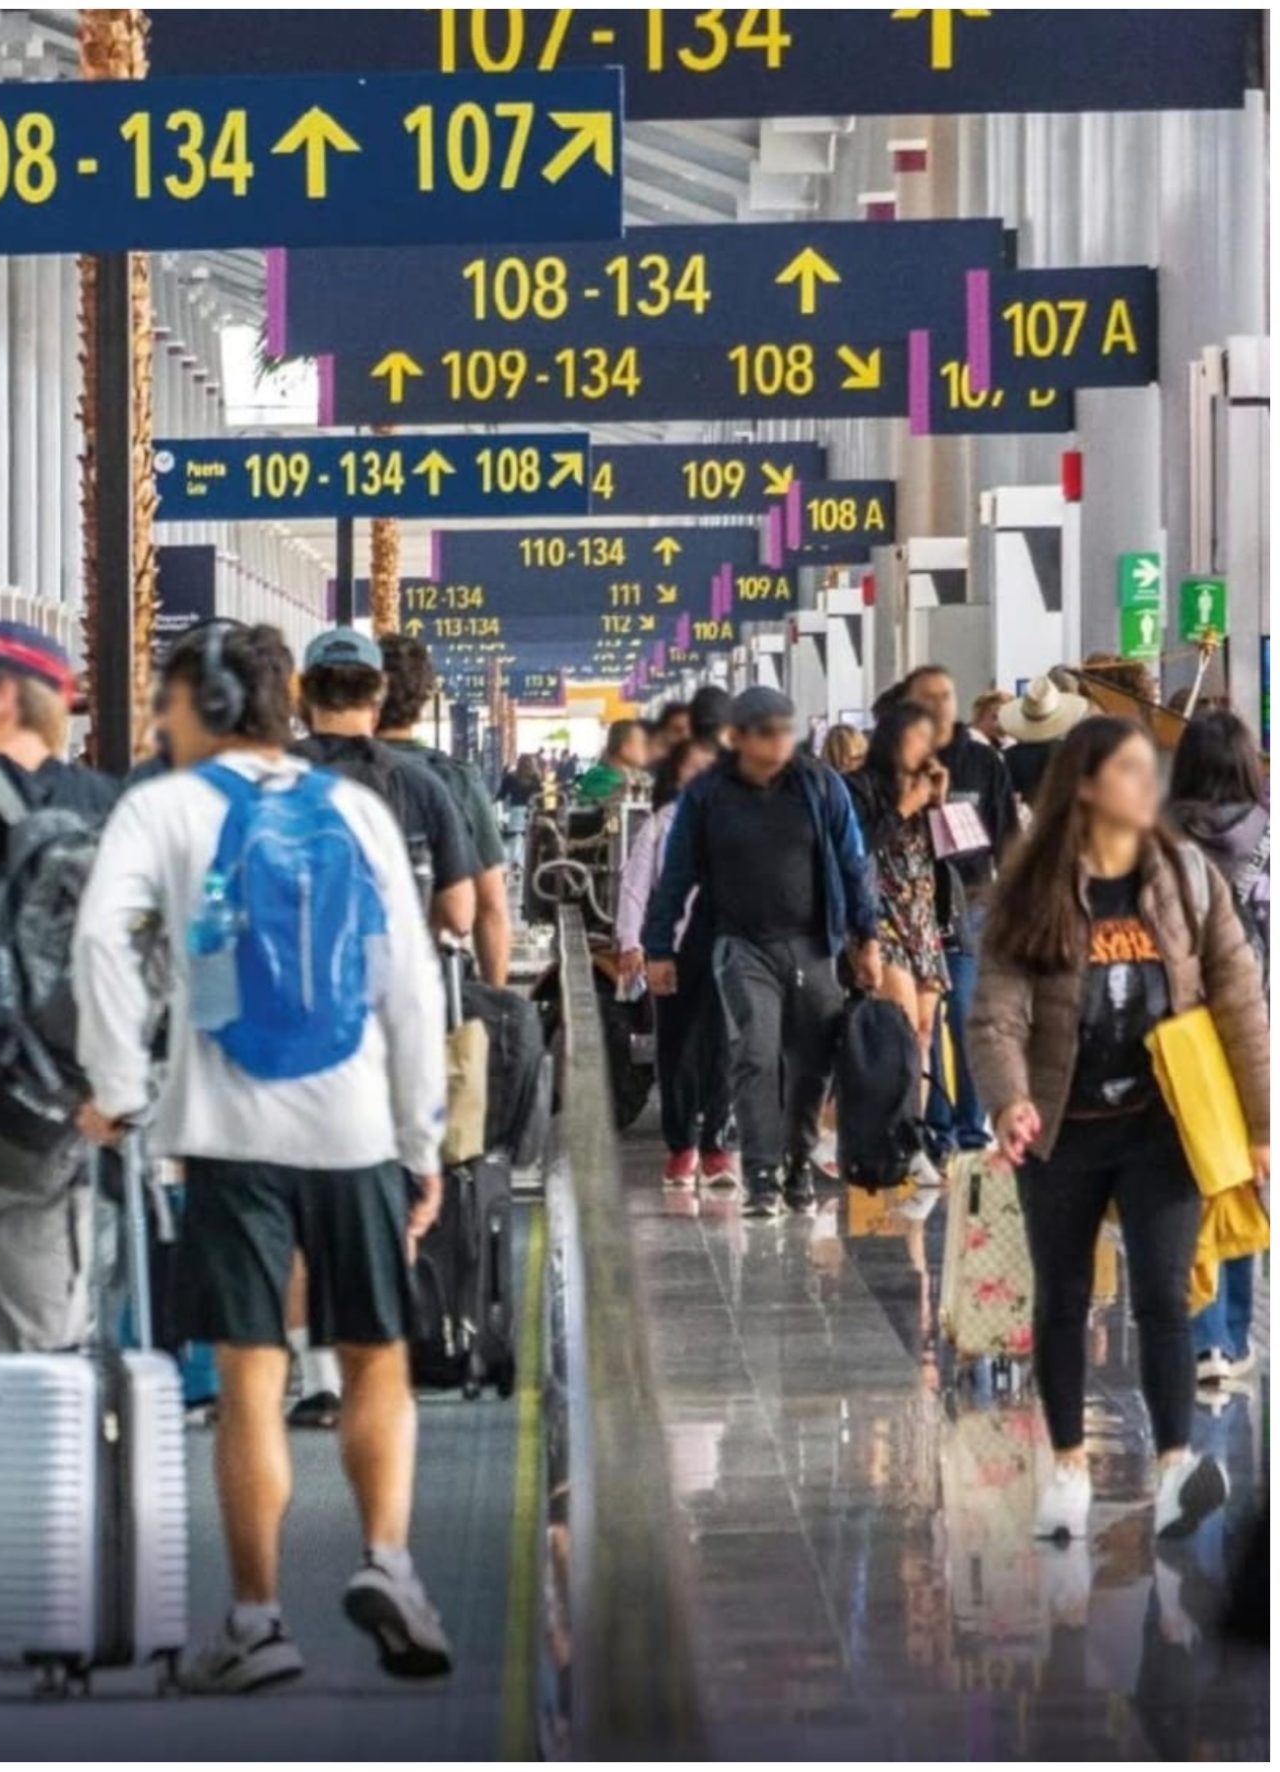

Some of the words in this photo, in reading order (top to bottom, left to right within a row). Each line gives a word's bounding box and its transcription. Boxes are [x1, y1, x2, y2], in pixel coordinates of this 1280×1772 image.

[119, 109, 254, 200] 134
[403, 101, 535, 192] 107
[462, 255, 569, 320] 108
[1002, 299, 1088, 358] 107
[1101, 298, 1138, 355] A
[728, 342, 815, 396] 108
[245, 451, 311, 498] 109
[340, 450, 406, 496] 134
[475, 446, 542, 493] 108
[682, 459, 746, 499] 109
[807, 498, 858, 532] 108
[864, 498, 885, 531] A
[519, 536, 626, 567] 110-134
[609, 582, 642, 606] 111
[736, 575, 772, 600] 109
[775, 575, 791, 599] A
[600, 614, 632, 634] 112
[693, 620, 720, 641] 110
[721, 621, 734, 640] A
